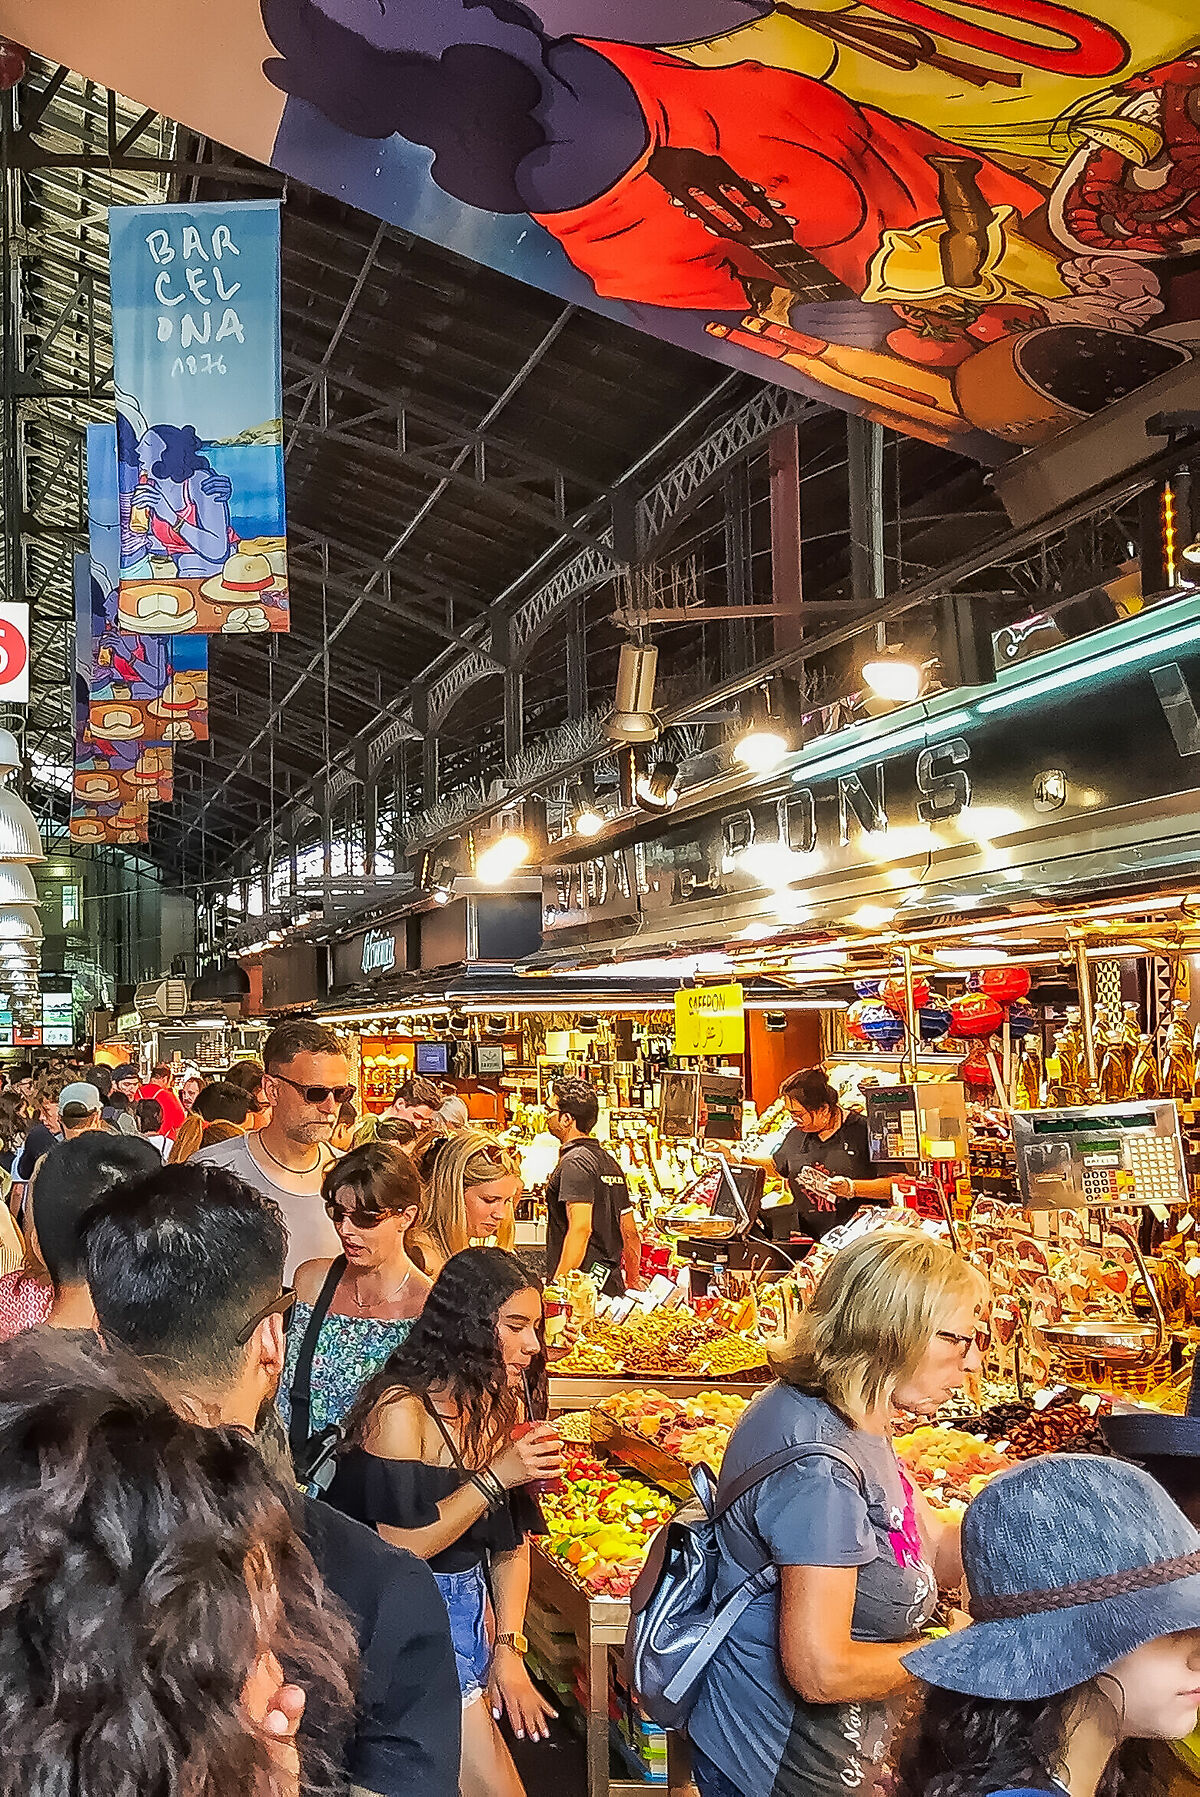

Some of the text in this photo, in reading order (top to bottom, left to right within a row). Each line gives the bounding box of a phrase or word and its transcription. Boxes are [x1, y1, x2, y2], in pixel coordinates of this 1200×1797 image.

[146, 225, 240, 264] BAR
[154, 266, 241, 306] CEL
[157, 308, 245, 348] ONA
[171, 353, 227, 378] 1876
